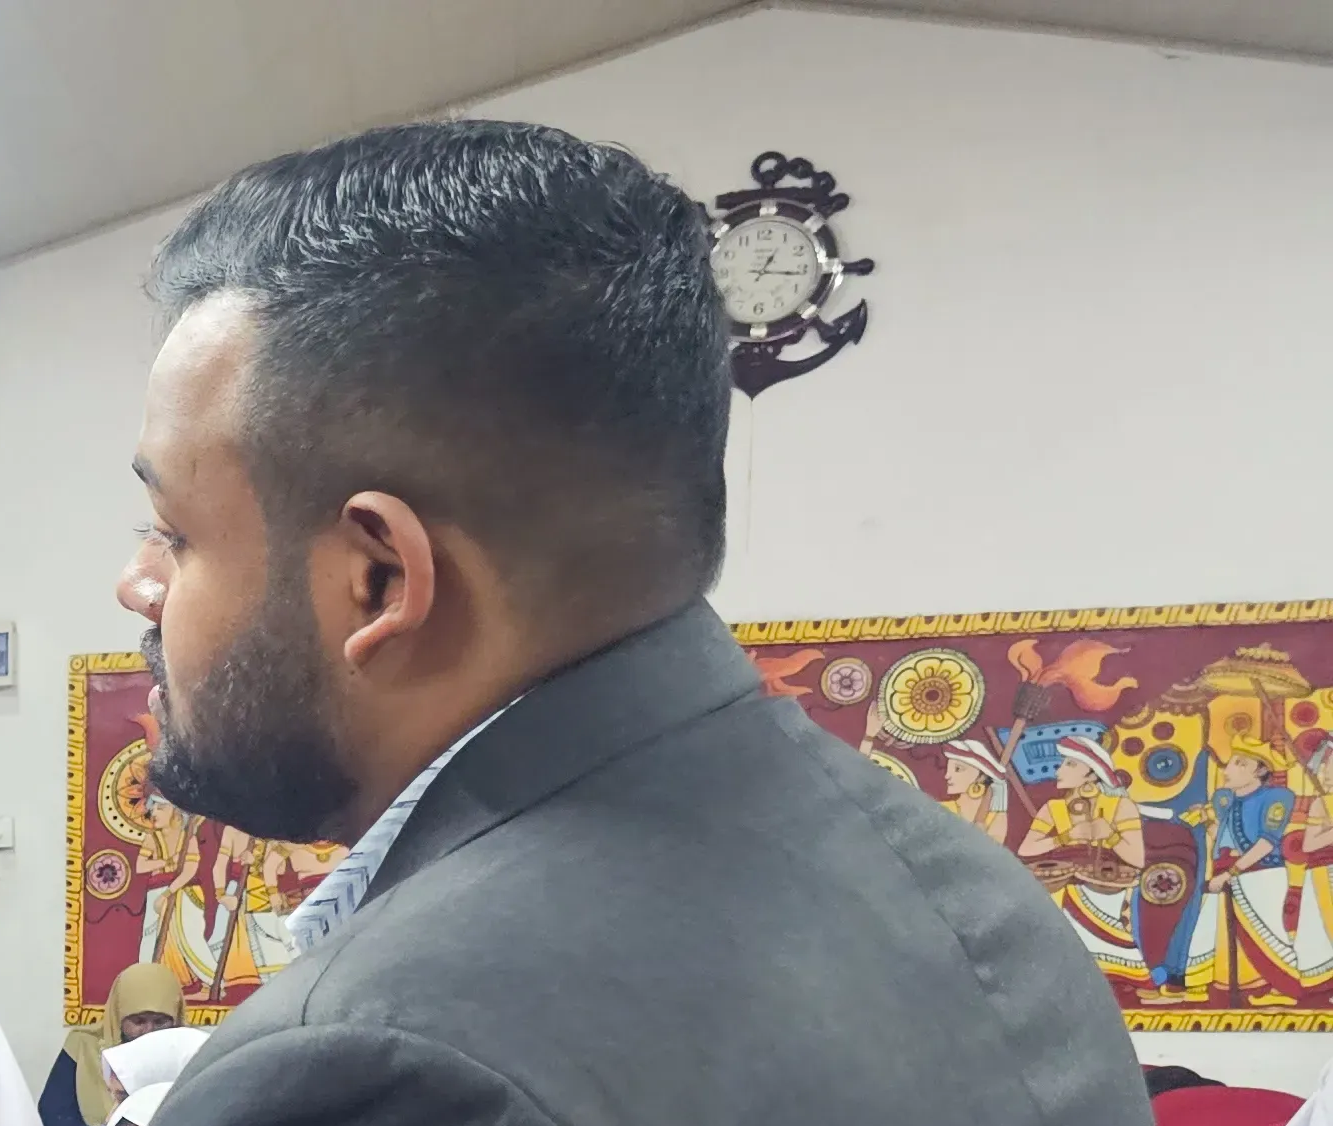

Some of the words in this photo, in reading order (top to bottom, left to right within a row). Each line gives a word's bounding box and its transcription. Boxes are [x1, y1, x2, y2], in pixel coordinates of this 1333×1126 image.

[738, 235, 750, 247] 11
[756, 229, 773, 241] 12
[782, 232, 789, 244] 1
[792, 245, 804, 257] 2
[753, 302, 765, 315] 6
